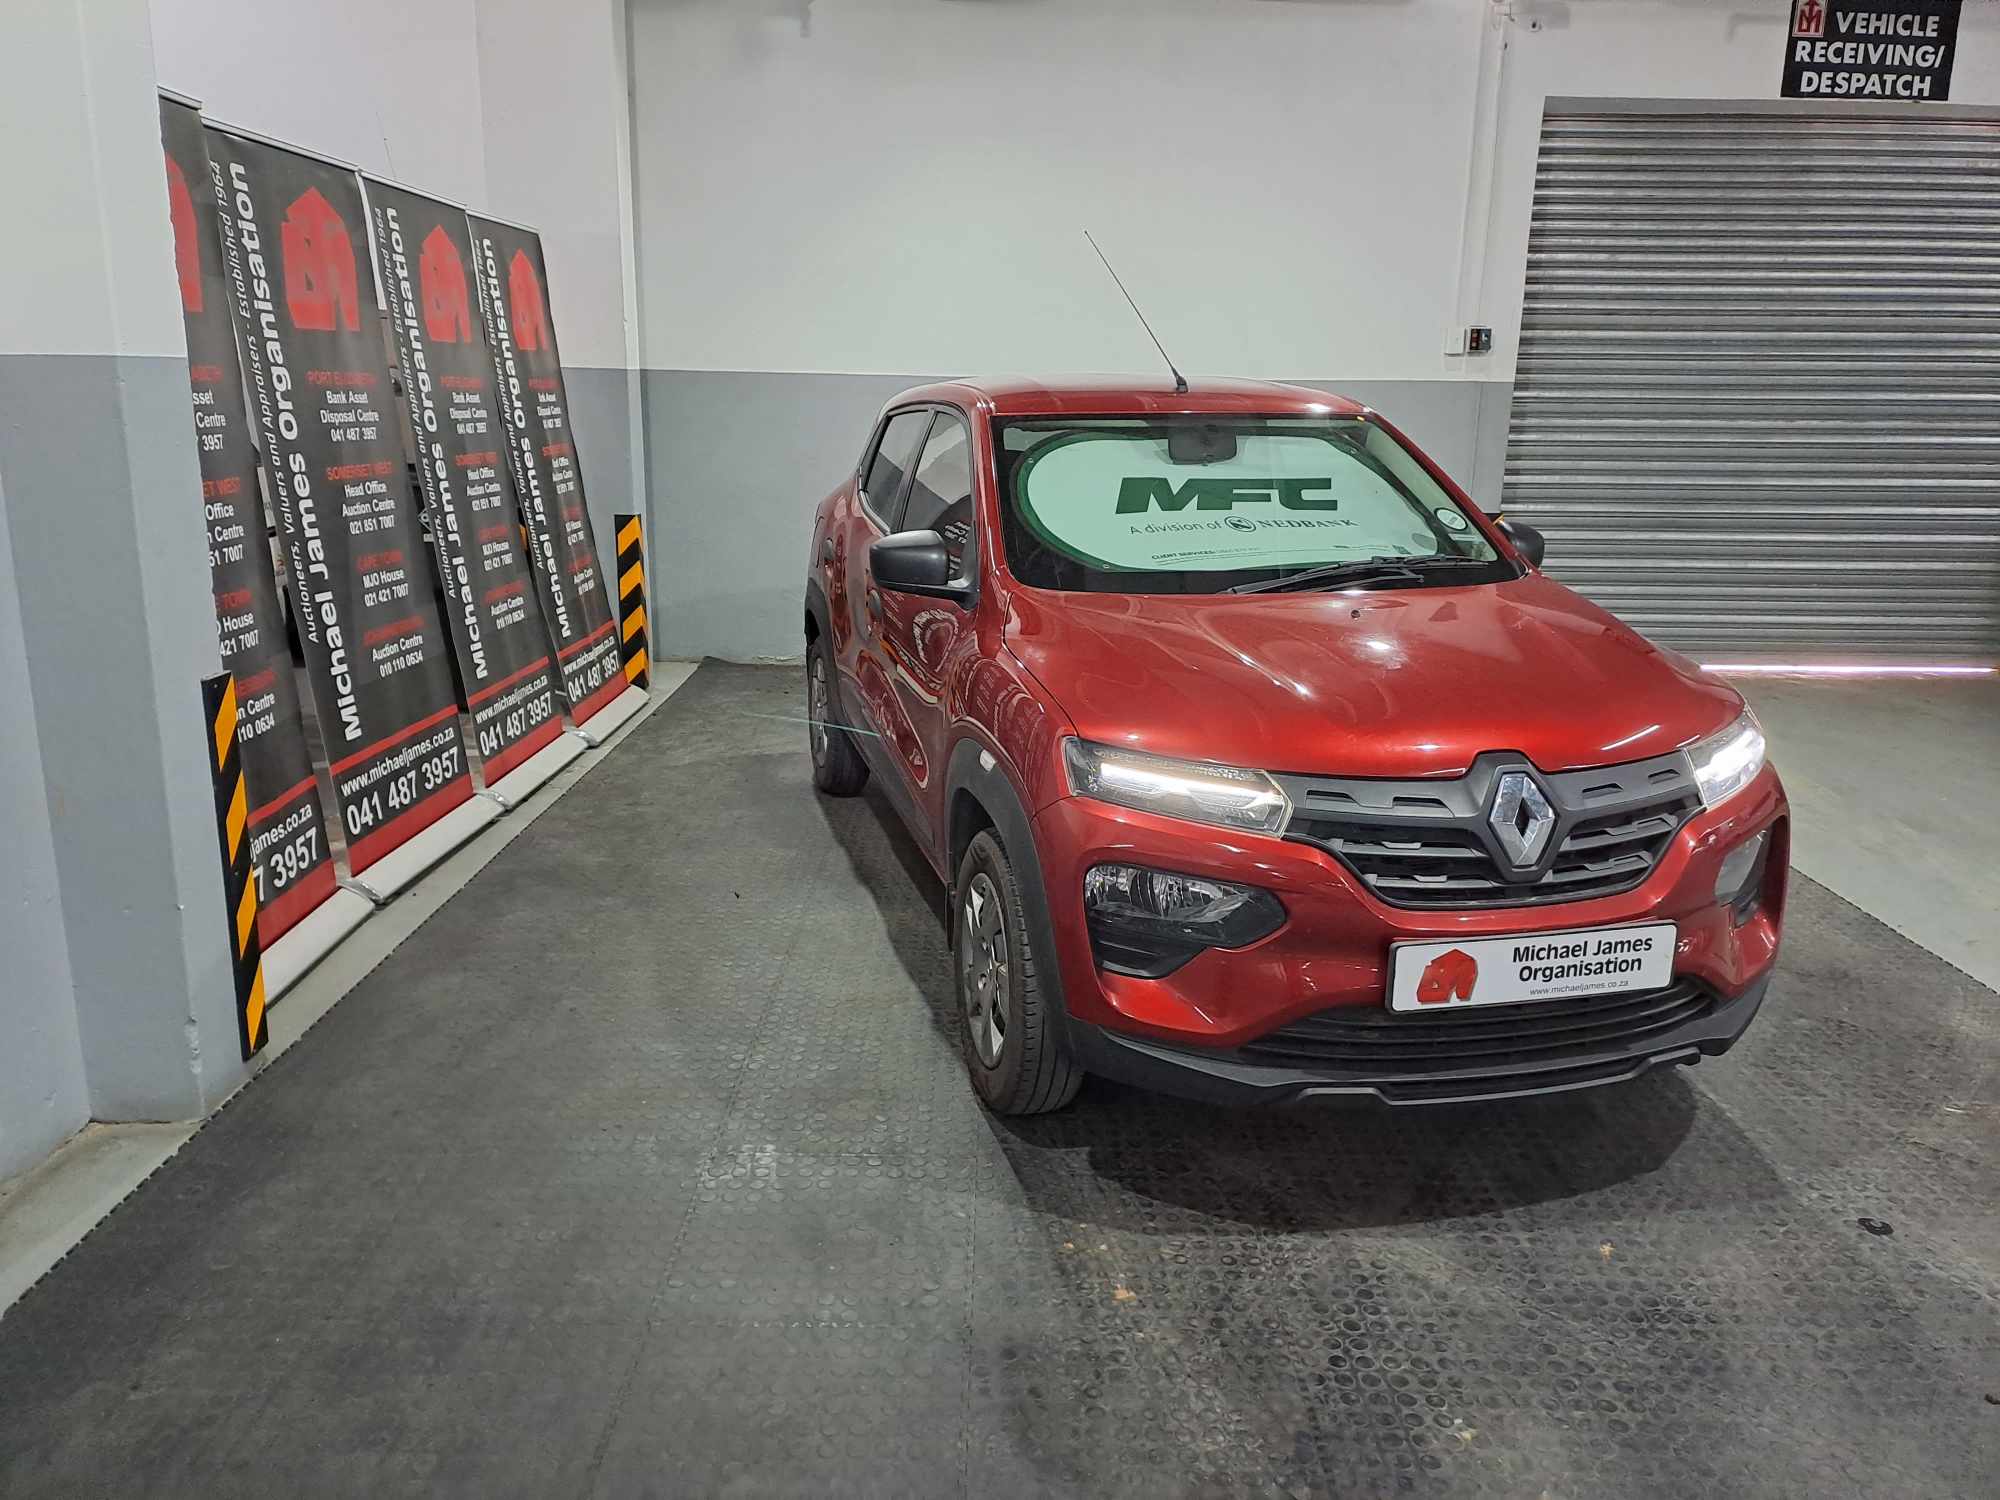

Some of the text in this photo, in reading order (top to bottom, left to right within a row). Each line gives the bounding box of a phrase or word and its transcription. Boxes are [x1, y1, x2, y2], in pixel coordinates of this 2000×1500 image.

[1836, 11, 1940, 37] VEHICLE
[1794, 40, 1945, 68] RECEIVING/
[1799, 71, 1931, 96] DESPATCH
[210, 161, 228, 207] 1964
[220, 213, 251, 319] Established
[482, 238, 526, 429] Organisation
[247, 334, 274, 428] Appraisers
[192, 388, 214, 405] sset
[196, 409, 226, 429] Centre
[320, 408, 356, 425] Disposal
[203, 434, 224, 451] 3957
[228, 161, 363, 742] Michael James Organisation
[264, 432, 280, 466] and
[387, 207, 488, 680] Michael James Organisation
[413, 425, 426, 454] and
[364, 480, 387, 496] Office
[520, 437, 546, 526] James
[1115, 477, 1338, 514] MFC
[205, 502, 234, 521] Office
[273, 471, 295, 534] Valuers
[342, 497, 395, 518] Auction Centre
[214, 523, 245, 541] Centre
[1129, 518, 1359, 535] A division of NEDBANK
[209, 543, 244, 568] 51 7007
[380, 568, 404, 586] House
[392, 582, 409, 600] 7007
[539, 533, 572, 638] Michael
[291, 541, 319, 644] Auctioneers,
[222, 612, 254, 633] House
[220, 629, 259, 657] 421 7007
[372, 633, 423, 663] Auction Centre
[379, 650, 423, 678] 010 110 0634
[568, 649, 620, 702] 041 487 3957
[247, 692, 275, 715] Centre
[255, 711, 275, 735] 0634
[480, 691, 552, 756] 041 487 3957
[341, 726, 455, 797] www.michaeljames.co.za
[346, 746, 459, 836] 041 487 3957
[270, 826, 318, 888] 3957
[1512, 937, 1653, 963] Michael James
[1519, 956, 1642, 983] Organisation
[1529, 979, 1629, 996] www.michaeljames.co.za
